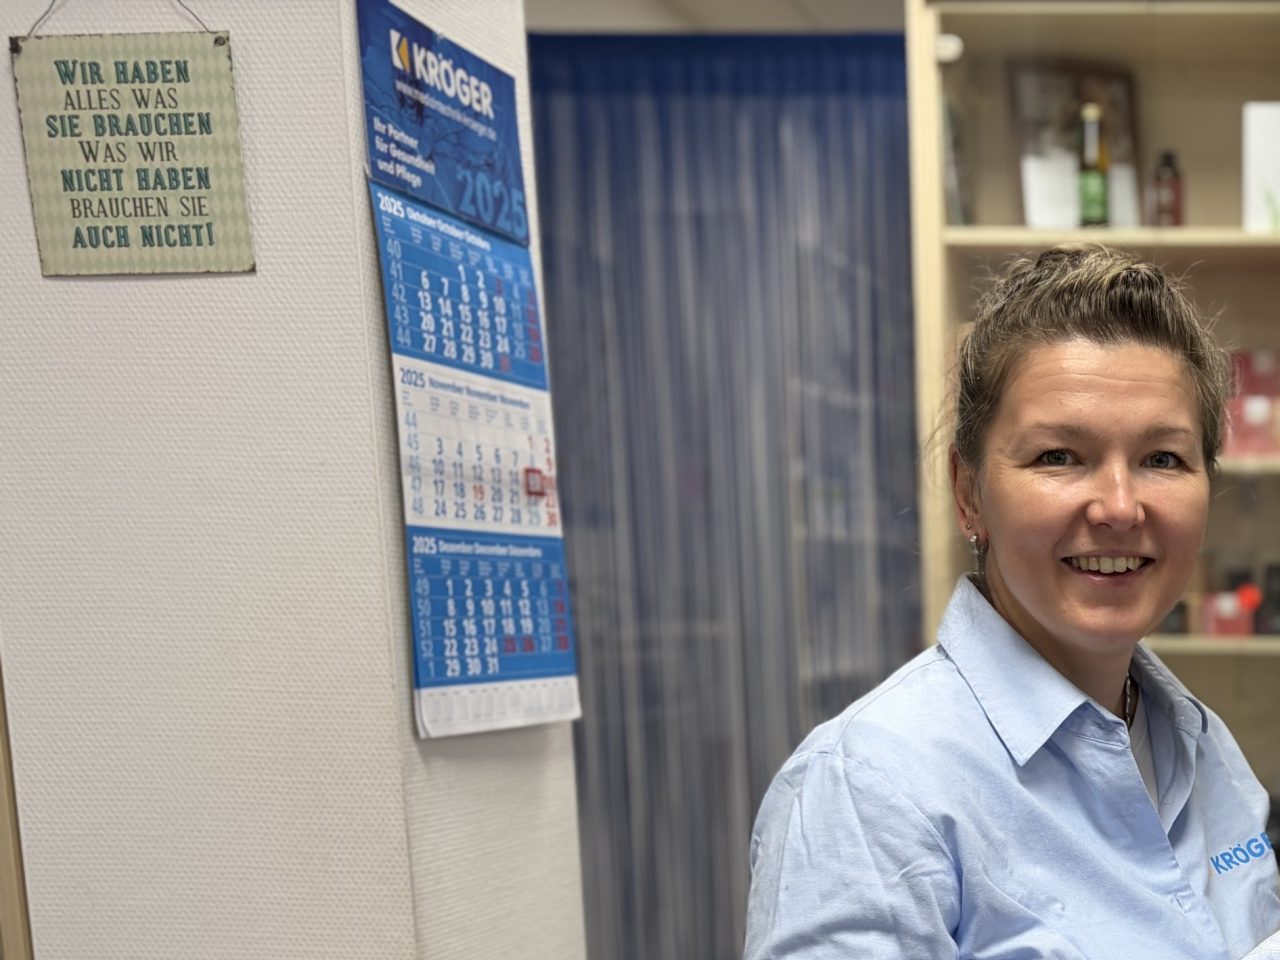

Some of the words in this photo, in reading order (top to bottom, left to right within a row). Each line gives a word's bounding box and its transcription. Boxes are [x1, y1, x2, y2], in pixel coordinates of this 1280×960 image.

[54, 60, 104, 85] WIR
[114, 60, 190, 84] HABEN
[413, 43, 494, 120] KRÖGER
[64, 89, 121, 111] ALLES
[131, 88, 179, 110] WAS
[46, 115, 82, 137] SIE
[94, 112, 213, 136] BRAUCHEN
[374, 117, 386, 133] Ihr
[388, 122, 418, 148] Partner
[79, 141, 127, 163] WAS
[138, 142, 179, 162] WIR
[375, 136, 388, 152] für
[391, 141, 435, 175] Gesundheit
[61, 169, 124, 192] NICHT
[137, 167, 211, 190] HABEN
[378, 160, 396, 176] und
[70, 197, 168, 218] BRAUCHEN
[180, 196, 209, 217] SIE
[378, 193, 404, 218] 2025
[457, 168, 527, 238] 2025
[72, 225, 129, 248] AUCH
[141, 222, 215, 247] NICHT!
[400, 368, 425, 388] 2025
[413, 536, 437, 554] 2025
